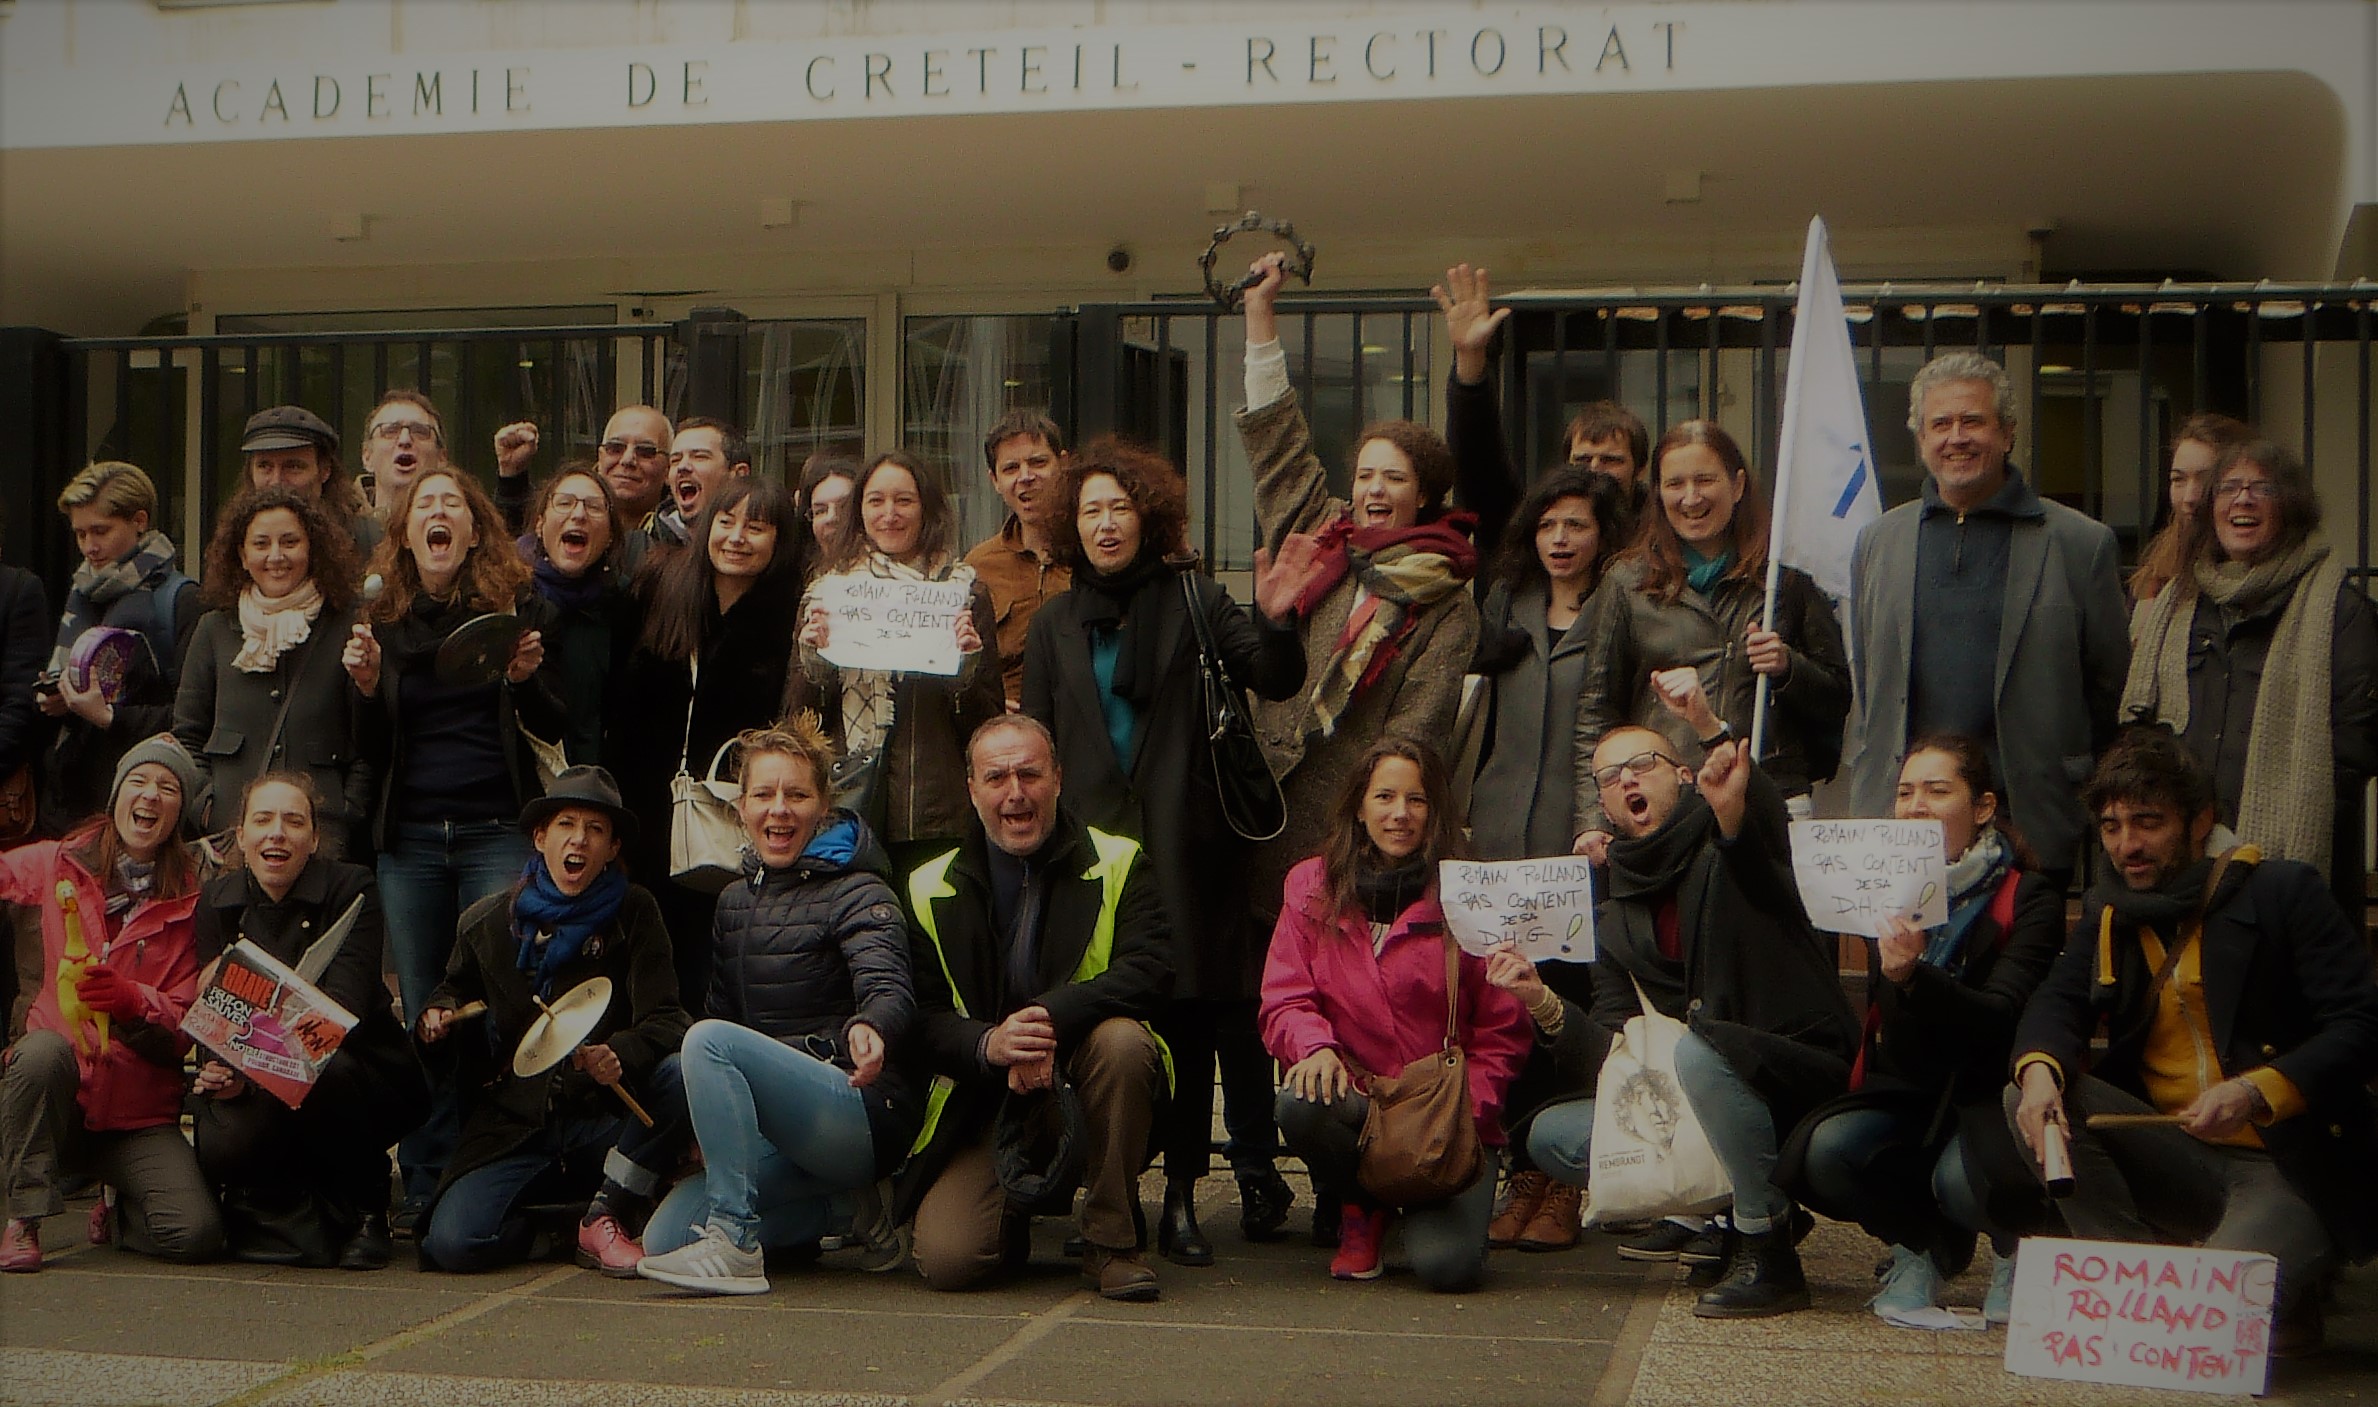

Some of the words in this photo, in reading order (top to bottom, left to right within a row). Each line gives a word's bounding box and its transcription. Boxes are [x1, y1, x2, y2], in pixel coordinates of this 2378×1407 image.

[164, 67, 532, 127] ACADEMIE
[627, 60, 709, 108] DE
[1245, 21, 1686, 86] RECTORAT
[900, 584, 962, 607] ROLLAND
[839, 605, 872, 622] PAS
[887, 608, 956, 630] CONTENT
[1810, 823, 1866, 844] ROMAIN
[1873, 824, 1941, 848] ROLLAND
[1459, 865, 1508, 885] ROMAIN
[1517, 864, 1588, 886] ROLLAND
[1811, 853, 1848, 874] PAS
[1863, 853, 1935, 876] CONTENT
[1458, 891, 1493, 911] PAS
[1508, 890, 1583, 911] CONTENT
[206, 995, 248, 1027] SAUVER
[210, 986, 253, 1018] PEUT-ON
[2042, 1331, 2104, 1367] PAS
